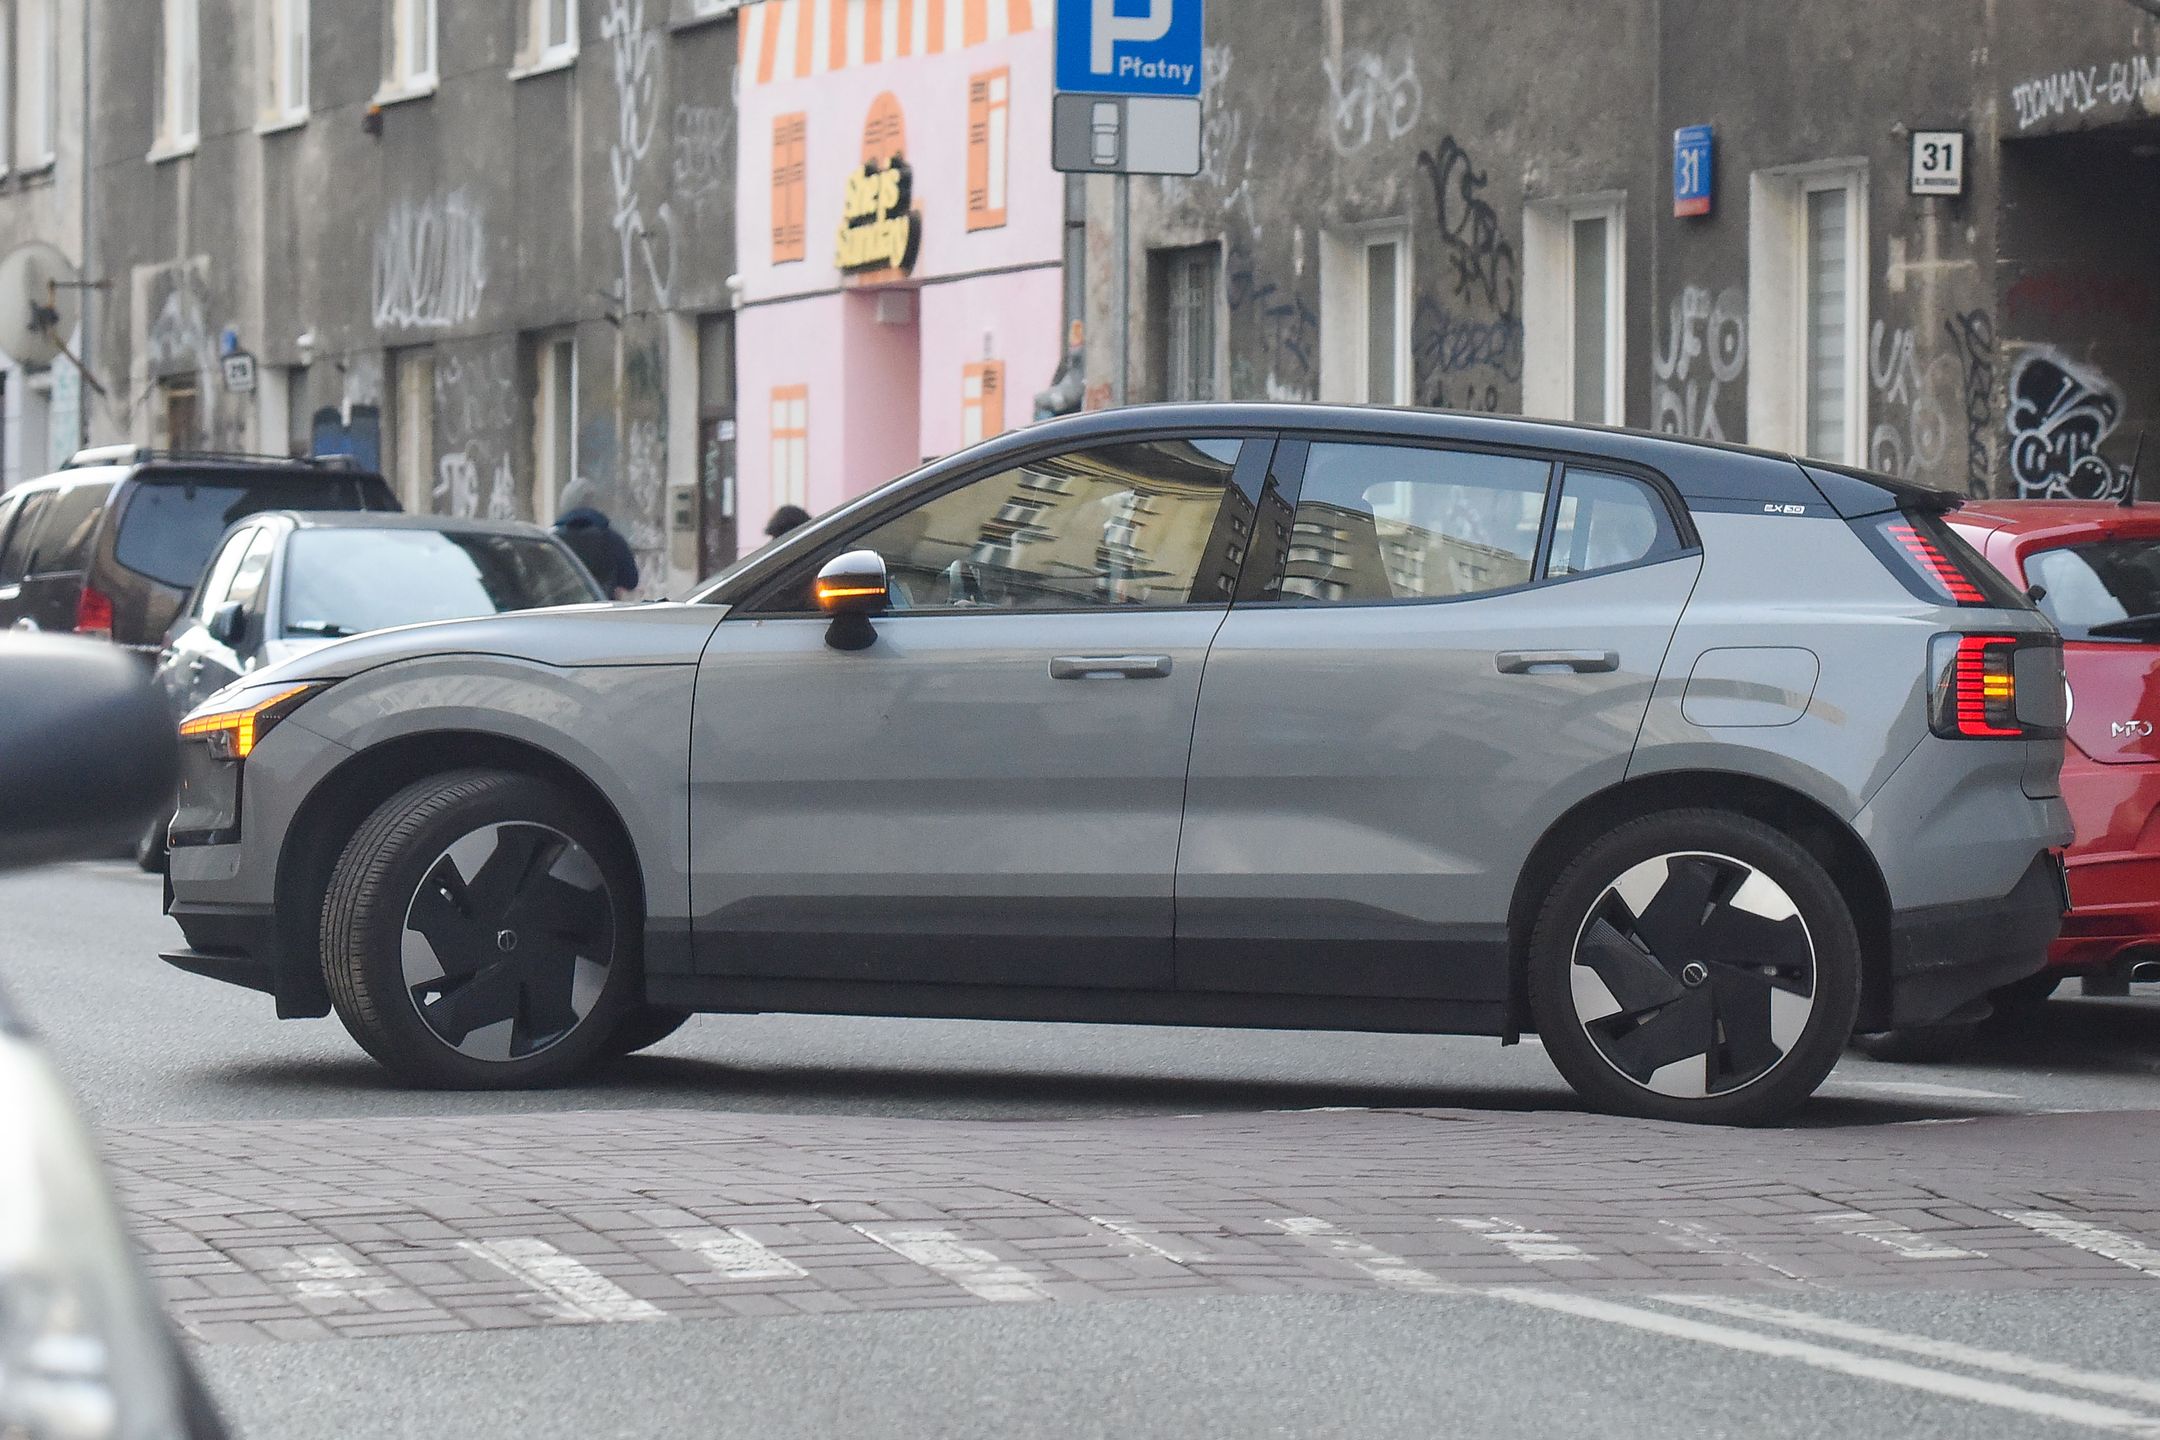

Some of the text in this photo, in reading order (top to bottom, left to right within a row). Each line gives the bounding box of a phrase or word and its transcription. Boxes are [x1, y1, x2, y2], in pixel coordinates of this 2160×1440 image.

[1090, 0, 1174, 75] P
[1118, 55, 1194, 86] Płatny
[1680, 147, 1699, 195] 31
[1923, 142, 1953, 171] 31
